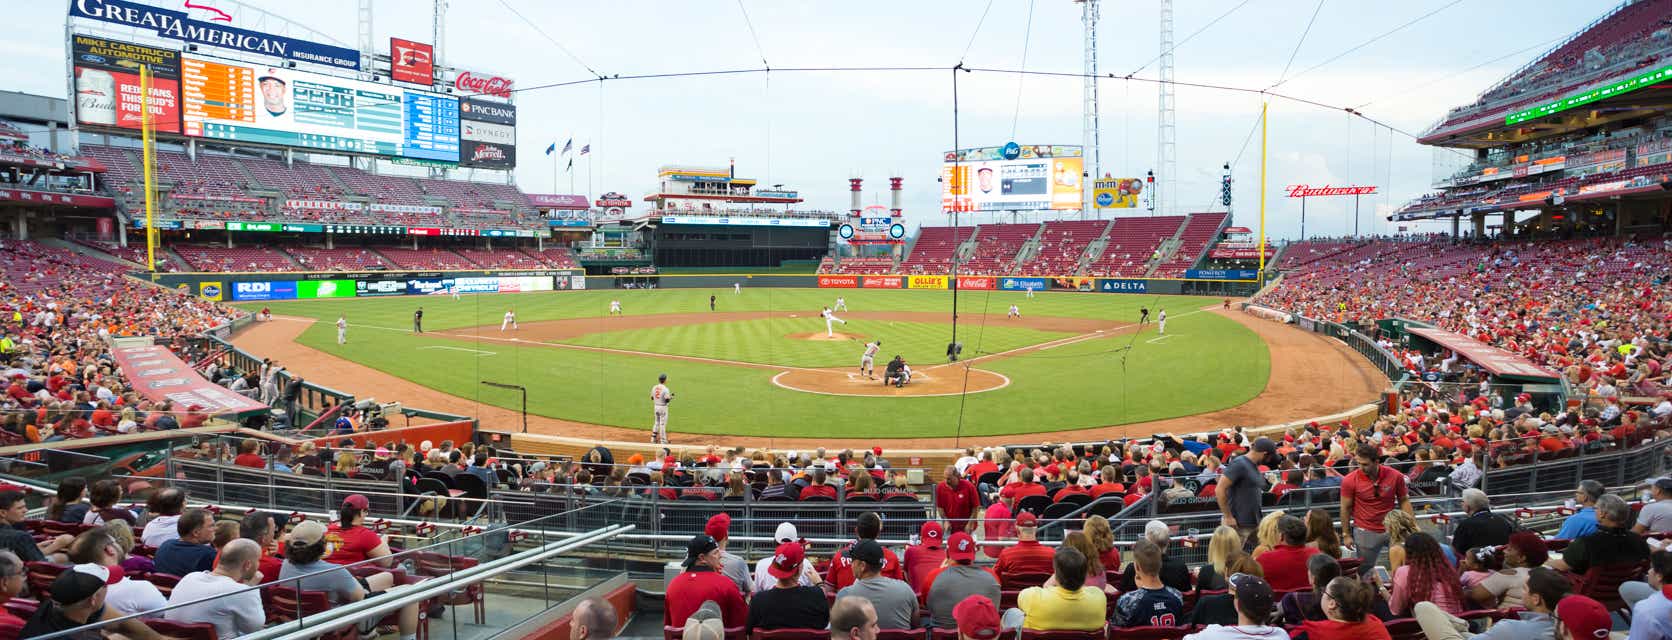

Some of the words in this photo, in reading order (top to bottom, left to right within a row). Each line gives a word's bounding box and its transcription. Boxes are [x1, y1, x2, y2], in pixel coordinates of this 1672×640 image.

[76, 36, 107, 47] MIKE
[110, 42, 175, 59] CASTRUCCI
[165, 17, 287, 55] AMERICAN
[293, 50, 333, 64] INSURANCE
[333, 57, 357, 68] GROUP
[89, 46, 163, 64] AUTOMOTIVE
[456, 71, 513, 98] Coca-Cola
[121, 102, 141, 112] FOR
[146, 96, 175, 108] BUD'S
[472, 104, 490, 115] PNC
[491, 107, 514, 118] BANK
[475, 127, 511, 138] DYNEGY
[472, 149, 504, 161] Morrell
[1285, 184, 1377, 198] Budweiser
[237, 282, 271, 293] RDI
[963, 279, 988, 288] Coca-Cola
[1114, 282, 1145, 290] DELTA
